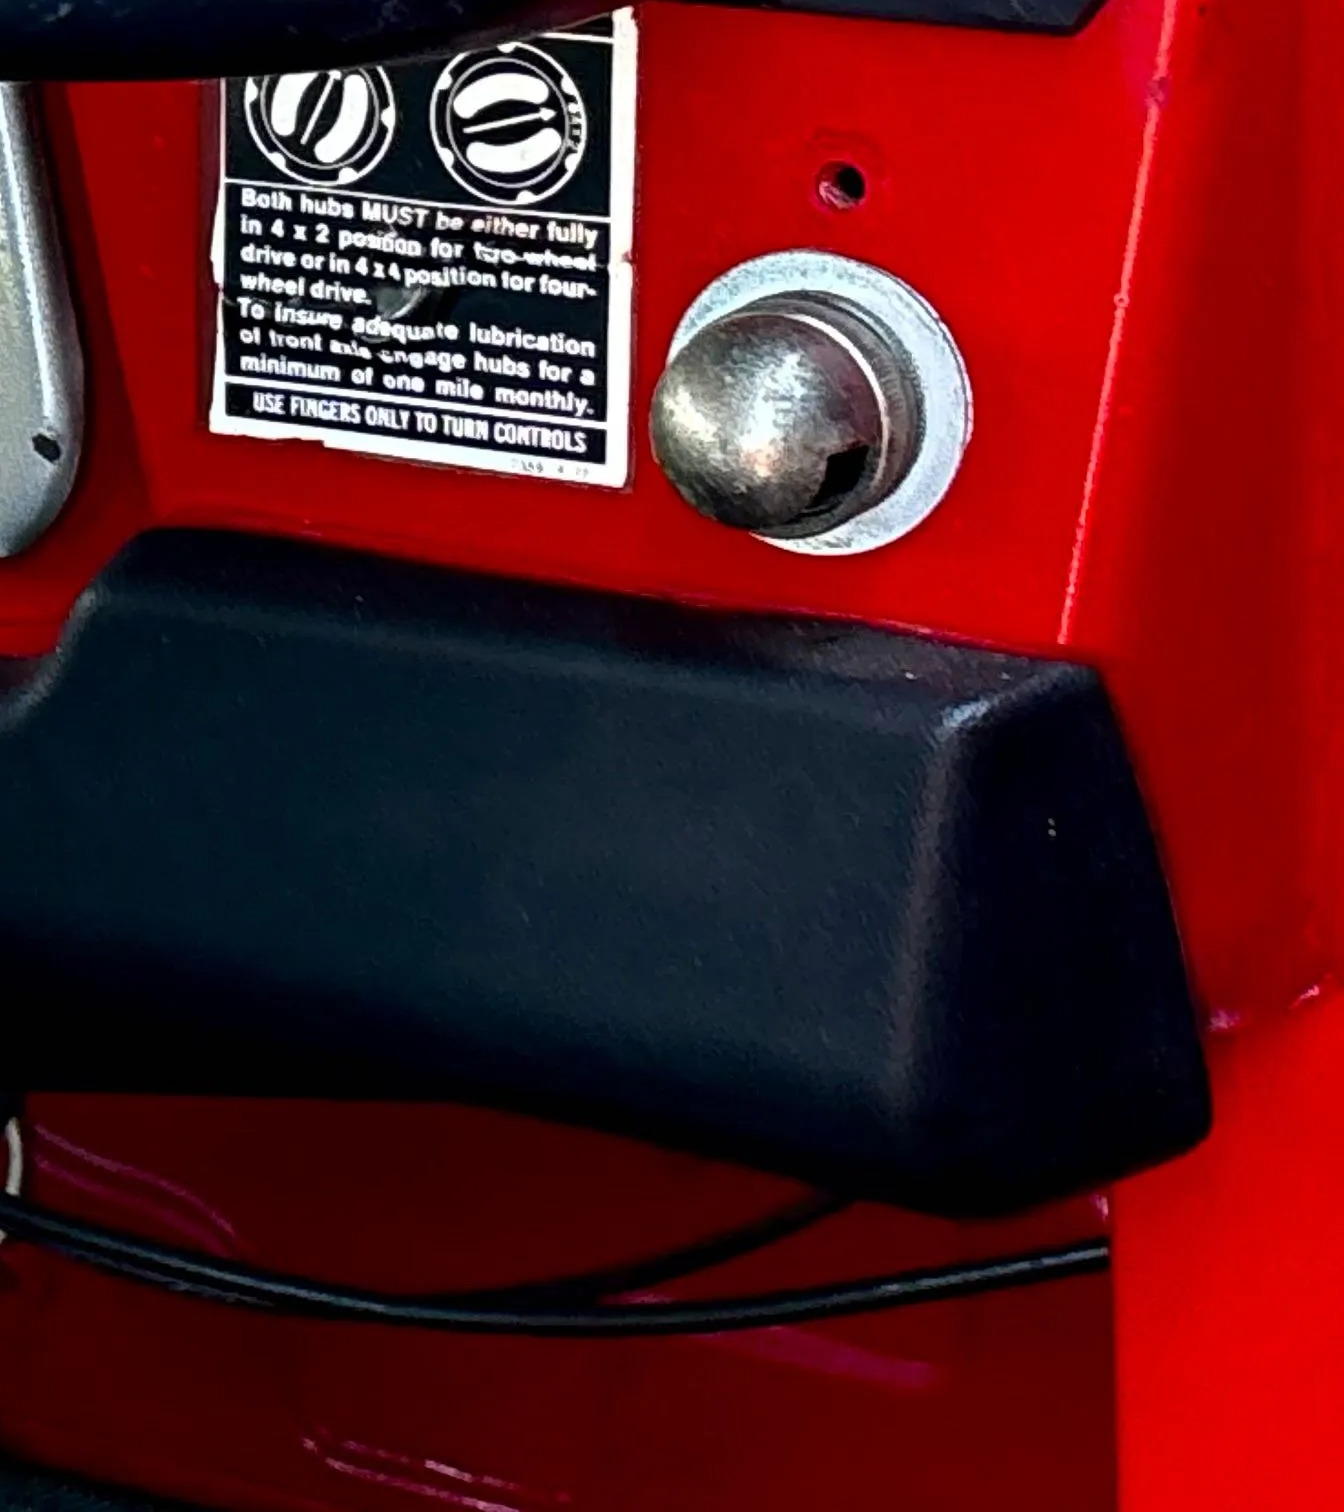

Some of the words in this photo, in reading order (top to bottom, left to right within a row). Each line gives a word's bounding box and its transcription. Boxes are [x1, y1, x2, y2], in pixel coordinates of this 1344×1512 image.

[240, 214, 262, 235] in
[271, 219, 284, 237] 4
[315, 223, 330, 243] 2
[430, 237, 464, 258] for
[241, 188, 292, 211] Both
[300, 194, 354, 218] hubs
[362, 201, 429, 228] MUST
[435, 210, 464, 230] be
[471, 215, 540, 239] either
[547, 221, 598, 249] fully
[240, 243, 296, 267] drive
[300, 253, 325, 270] or
[329, 252, 350, 273] in
[404, 263, 497, 289] position
[501, 270, 536, 293] for
[539, 274, 597, 300] four-
[240, 272, 305, 296] wheel
[309, 279, 372, 305] drive.
[237, 297, 265, 320] To
[274, 301, 343, 330] insure
[351, 316, 459, 345] adequate
[469, 322, 596, 358] lubrication
[240, 327, 261, 345] of
[269, 329, 322, 351] front
[378, 349, 467, 373] engage
[473, 350, 531, 378] hubs
[538, 359, 572, 383] for
[579, 368, 596, 386] a
[240, 353, 341, 382] minimum
[351, 367, 374, 386] of
[382, 374, 425, 393] one
[435, 377, 484, 401] mile
[494, 386, 595, 418] monthly.
[253, 391, 285, 415] USE
[290, 395, 361, 424] FINGERS
[365, 405, 410, 430] ONLY
[414, 410, 438, 434] TO
[441, 414, 489, 441] TURN
[493, 422, 587, 454] CONTROLS
